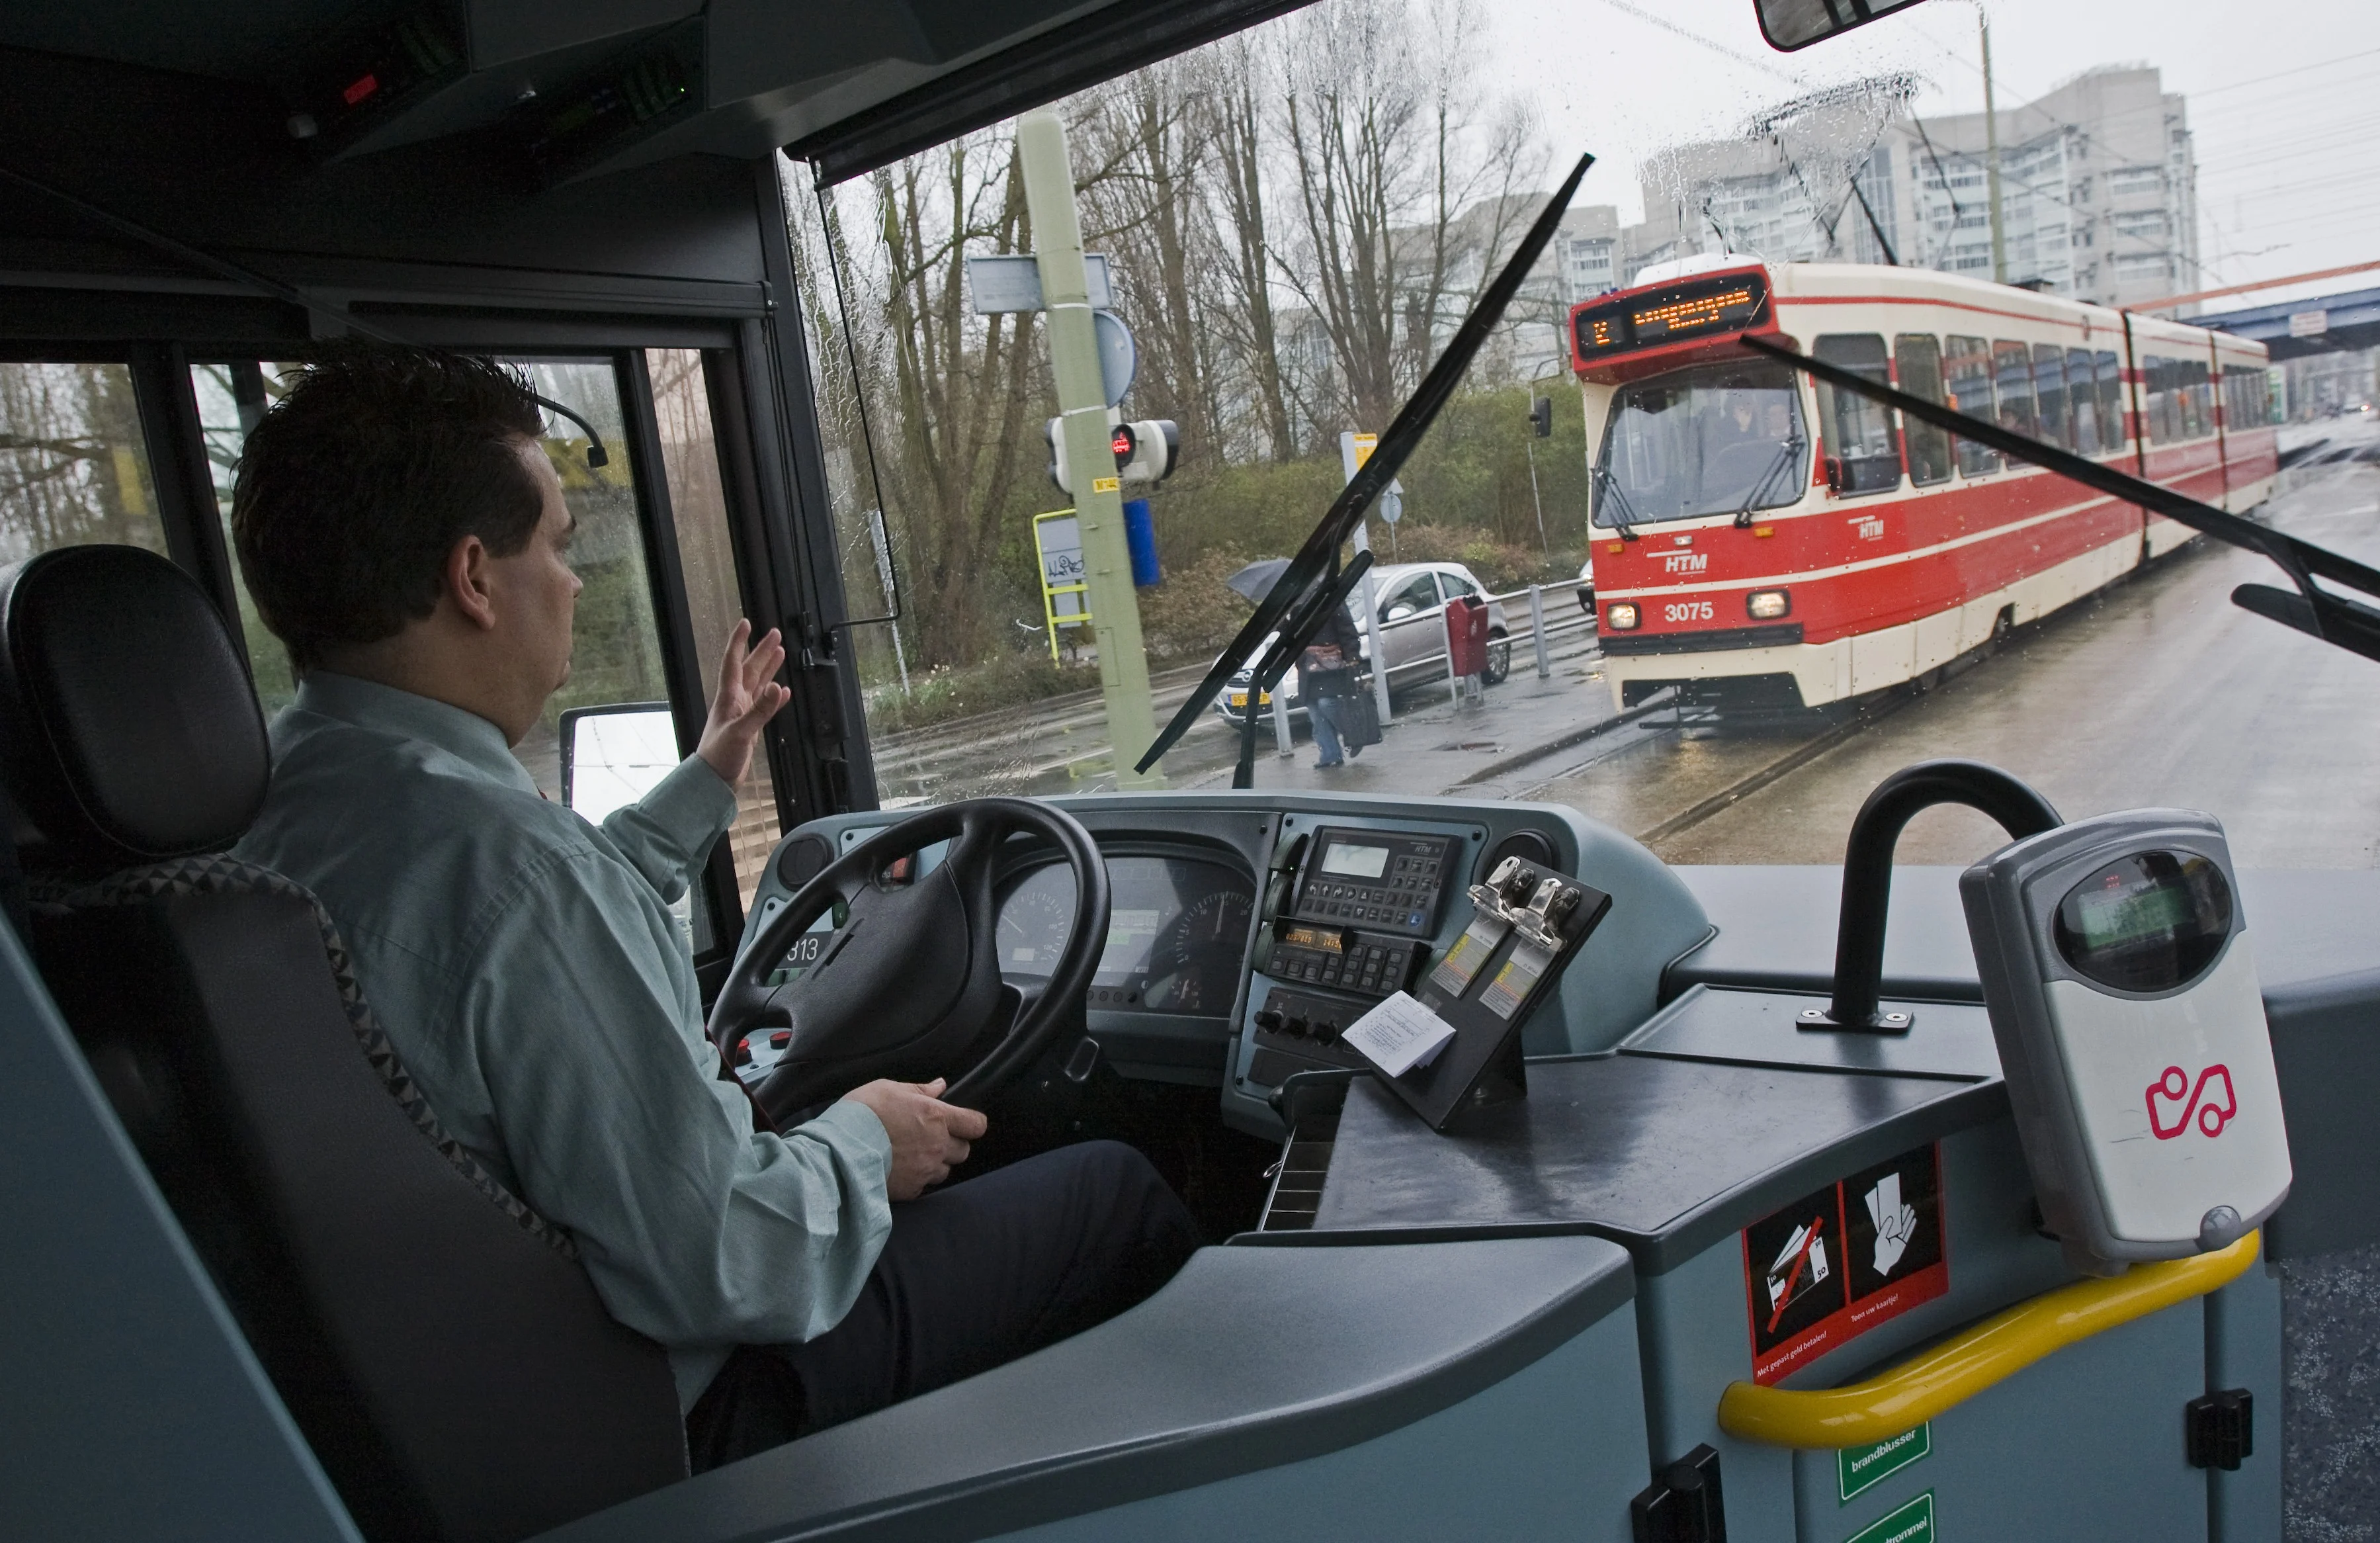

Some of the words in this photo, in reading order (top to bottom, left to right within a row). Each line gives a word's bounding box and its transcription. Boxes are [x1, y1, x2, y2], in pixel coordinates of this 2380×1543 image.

[1859, 519, 1884, 539] HTM
[1665, 553, 1708, 572] HTM
[1664, 601, 1714, 622] 3075
[1414, 845, 1432, 854] HTM
[786, 938, 819, 961] 313
[1817, 1266, 1826, 1279] 50
[1865, 1306, 1876, 1315] uw
[1876, 1292, 1899, 1310] kaartje!
[1757, 1364, 1769, 1378] Met
[1769, 1352, 1790, 1372] gepast
[1789, 1344, 1803, 1360] geld
[1803, 1329, 1828, 1350] betalen!
[1851, 1429, 1916, 1474] brandblusser
